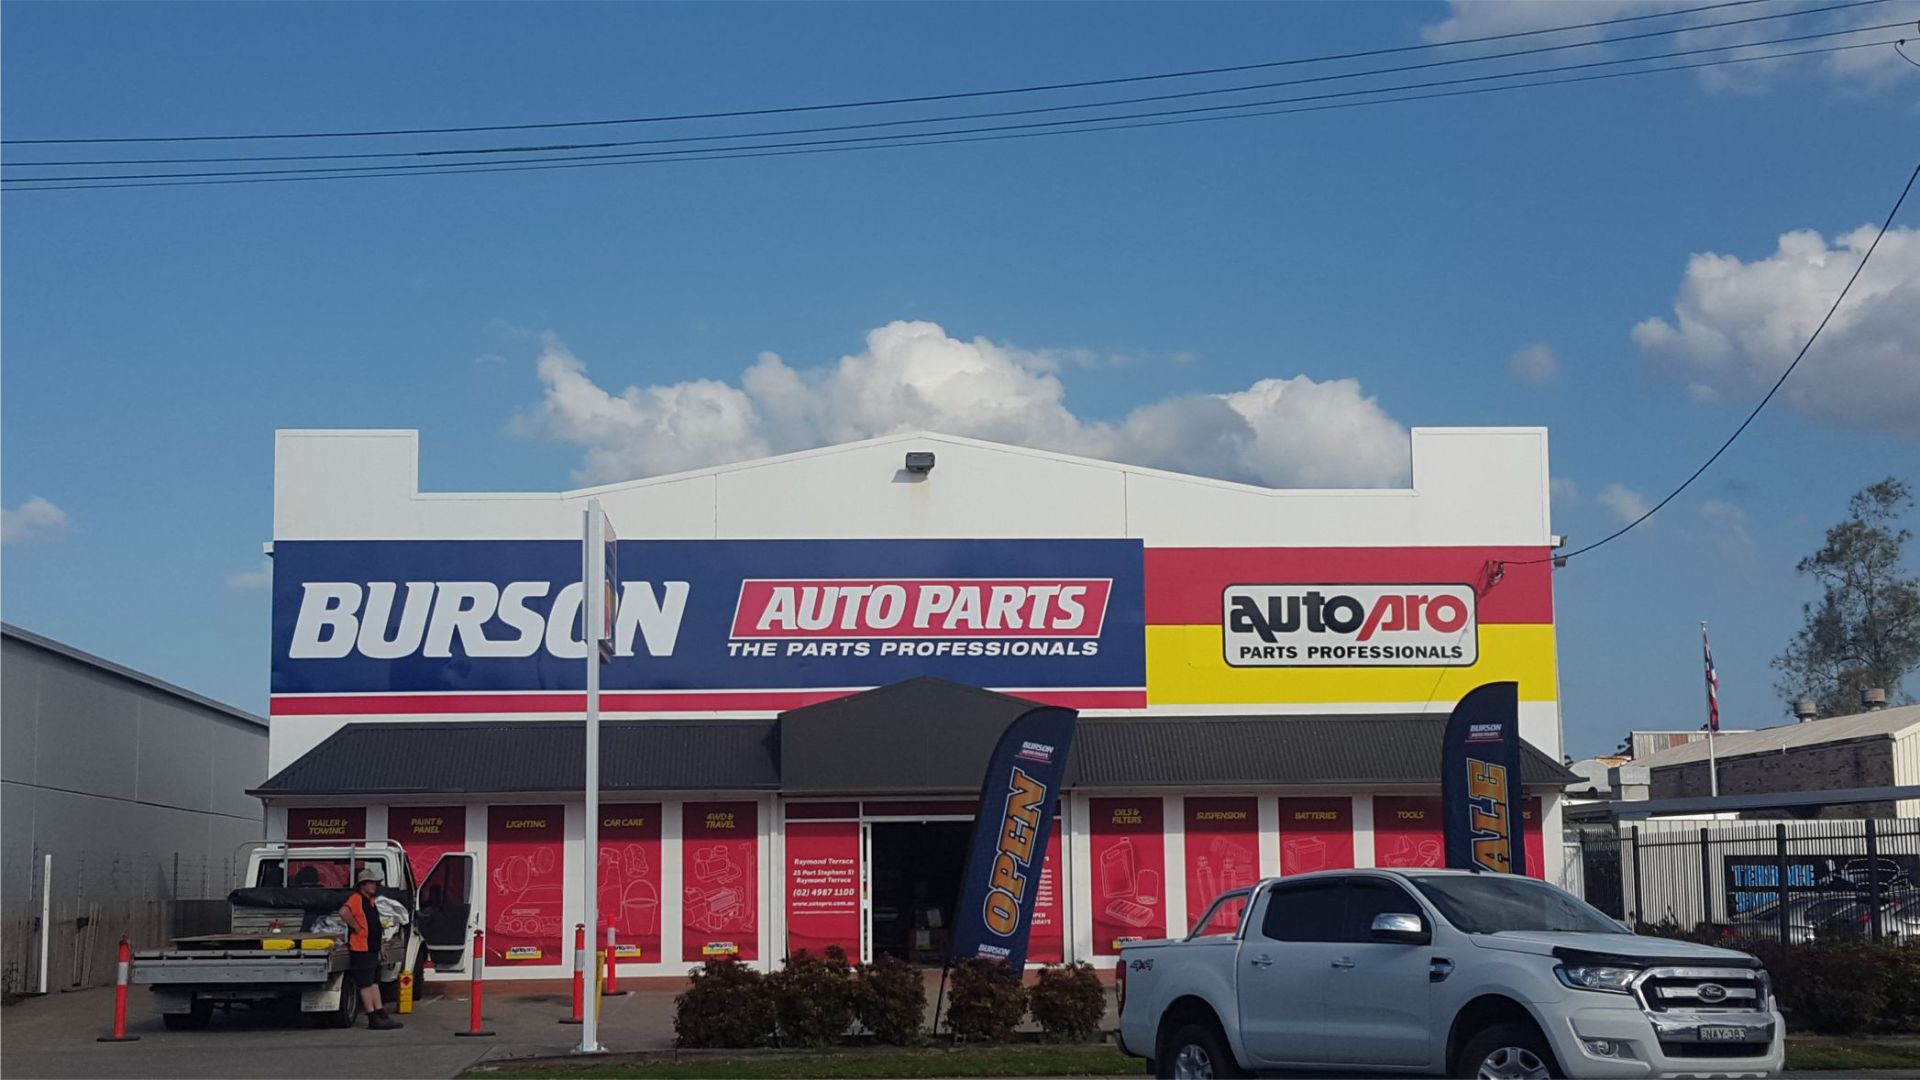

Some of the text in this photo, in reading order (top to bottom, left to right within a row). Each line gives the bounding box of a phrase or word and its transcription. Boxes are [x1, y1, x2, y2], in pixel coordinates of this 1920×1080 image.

[756, 584, 1087, 630] AUTO PARTS
[289, 581, 690, 659] BURSON
[727, 641, 1098, 657] THE PARTS PROFESSIONALS
[1240, 645, 1463, 659] PARTS PROFESSIONALS
[1470, 723, 1502, 732] BURSON
[1022, 741, 1054, 753] BURSON
[1196, 812, 1247, 820] SUSPENSION
[1295, 812, 1337, 820] BATTERIES
[1397, 811, 1424, 819] TOOLS
[1466, 757, 1512, 873] ALE
[307, 819, 341, 827] TRAILER
[411, 818, 436, 826] PAINT
[506, 820, 546, 828] LIGHTING
[603, 818, 645, 827] CAR CARE
[1112, 816, 1142, 824] FILTERS
[705, 821, 736, 829] TRAVEL
[309, 827, 346, 835] TOWING
[983, 766, 1046, 937] OPEN
[794, 858, 827, 866] Raymond
[817, 869, 846, 877] Stephens
[793, 888, 855, 898] (02) 4987 1100
[978, 943, 1011, 956] BURSON
